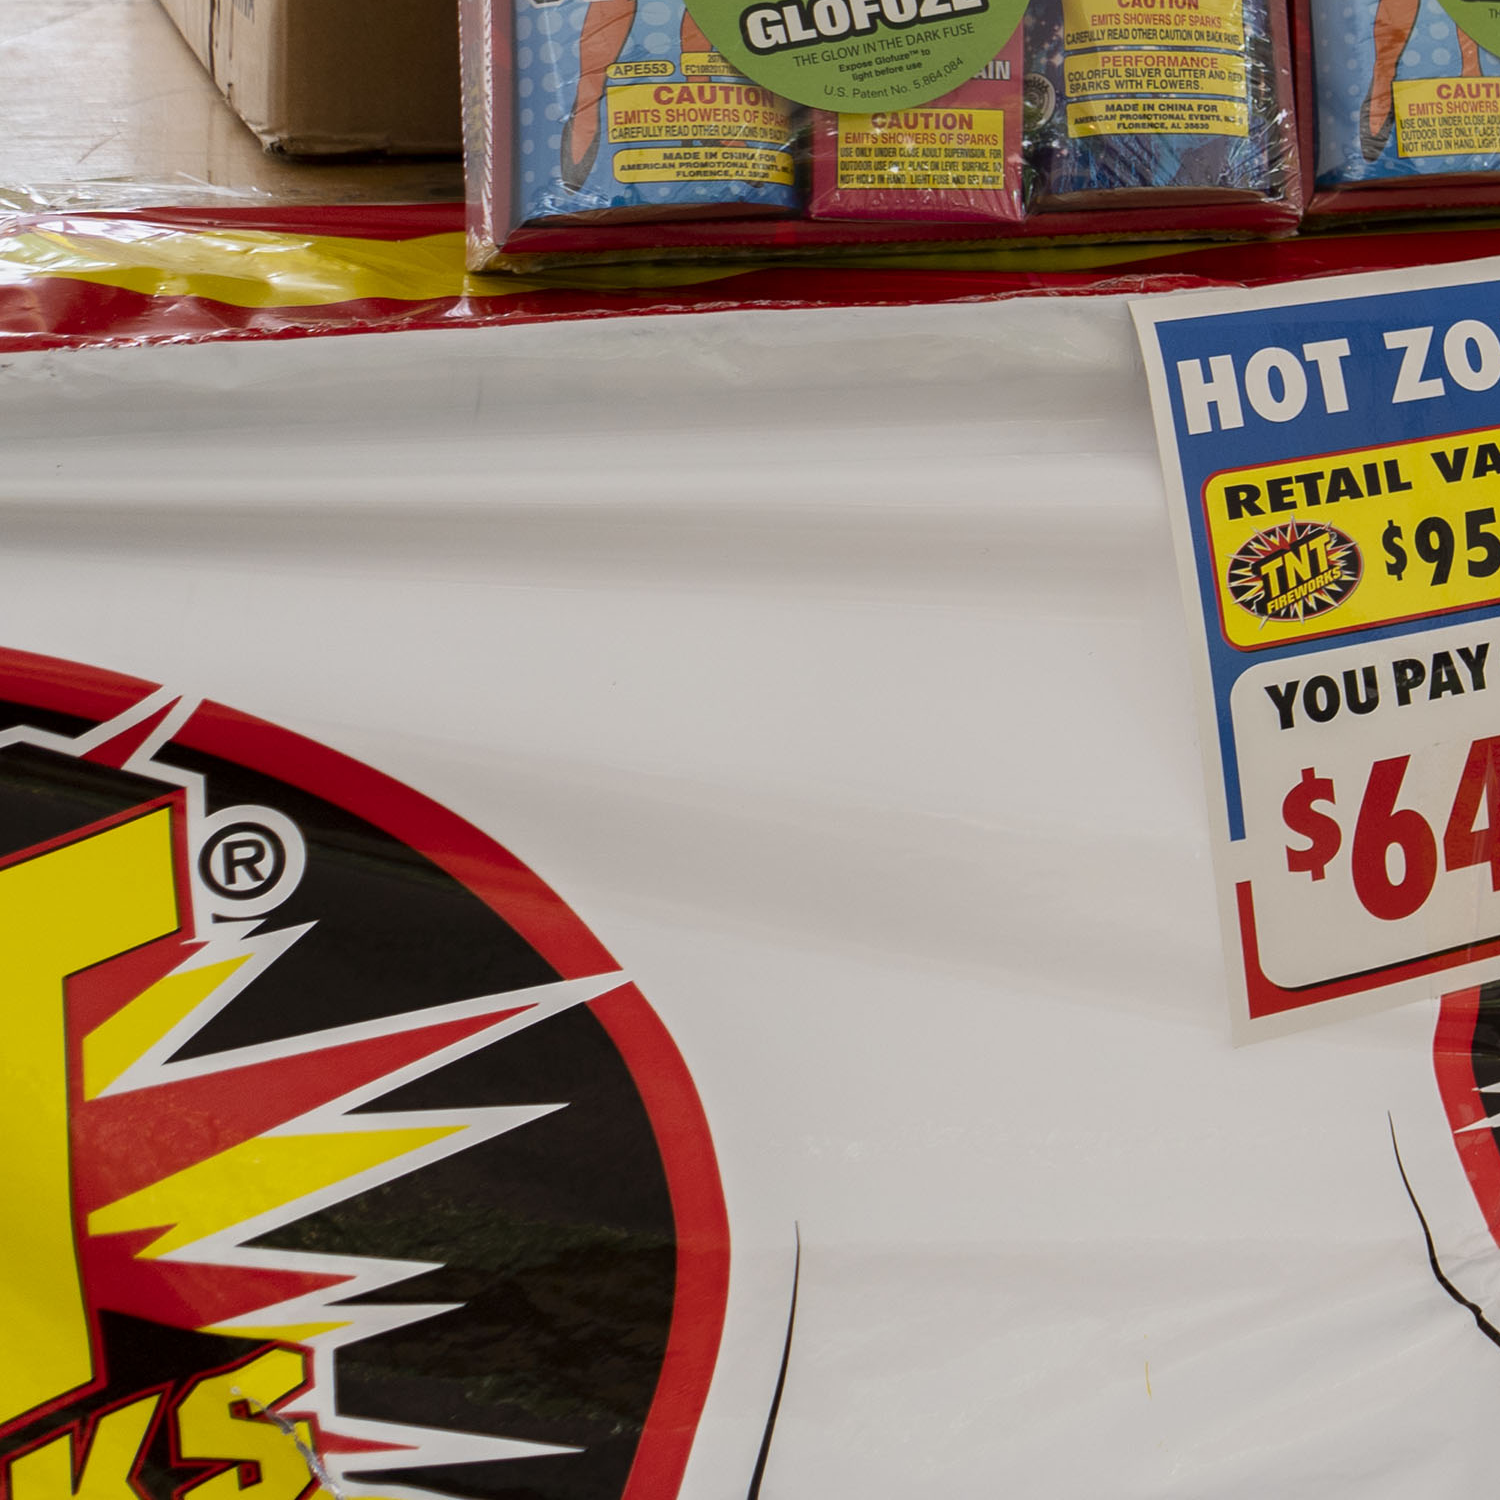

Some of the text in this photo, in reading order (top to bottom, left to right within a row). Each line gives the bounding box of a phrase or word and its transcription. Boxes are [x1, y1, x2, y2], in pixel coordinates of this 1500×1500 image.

[793, 21, 976, 70] THE GLOW IN THE DARK FUSE
[613, 63, 669, 77] APE553
[838, 59, 874, 75] Expose
[920, 47, 932, 58] to
[851, 60, 924, 83] light before use
[1100, 55, 1219, 69] PERFORMANCE
[653, 85, 776, 108] CAUTION
[823, 84, 849, 99] U.S.
[851, 86, 890, 100] Patent
[890, 81, 912, 95] No.
[871, 112, 974, 131] CAUTION
[844, 132, 999, 146] EMITS SHOWERS OF SPARKS
[1176, 337, 1352, 436] HOT
[1223, 457, 1413, 521] RETAIL
[1260, 532, 1335, 590] TNT
[1265, 566, 1344, 616] FIREWORKS
[1263, 663, 1378, 731] YOU
[1393, 642, 1490, 708] PAY
